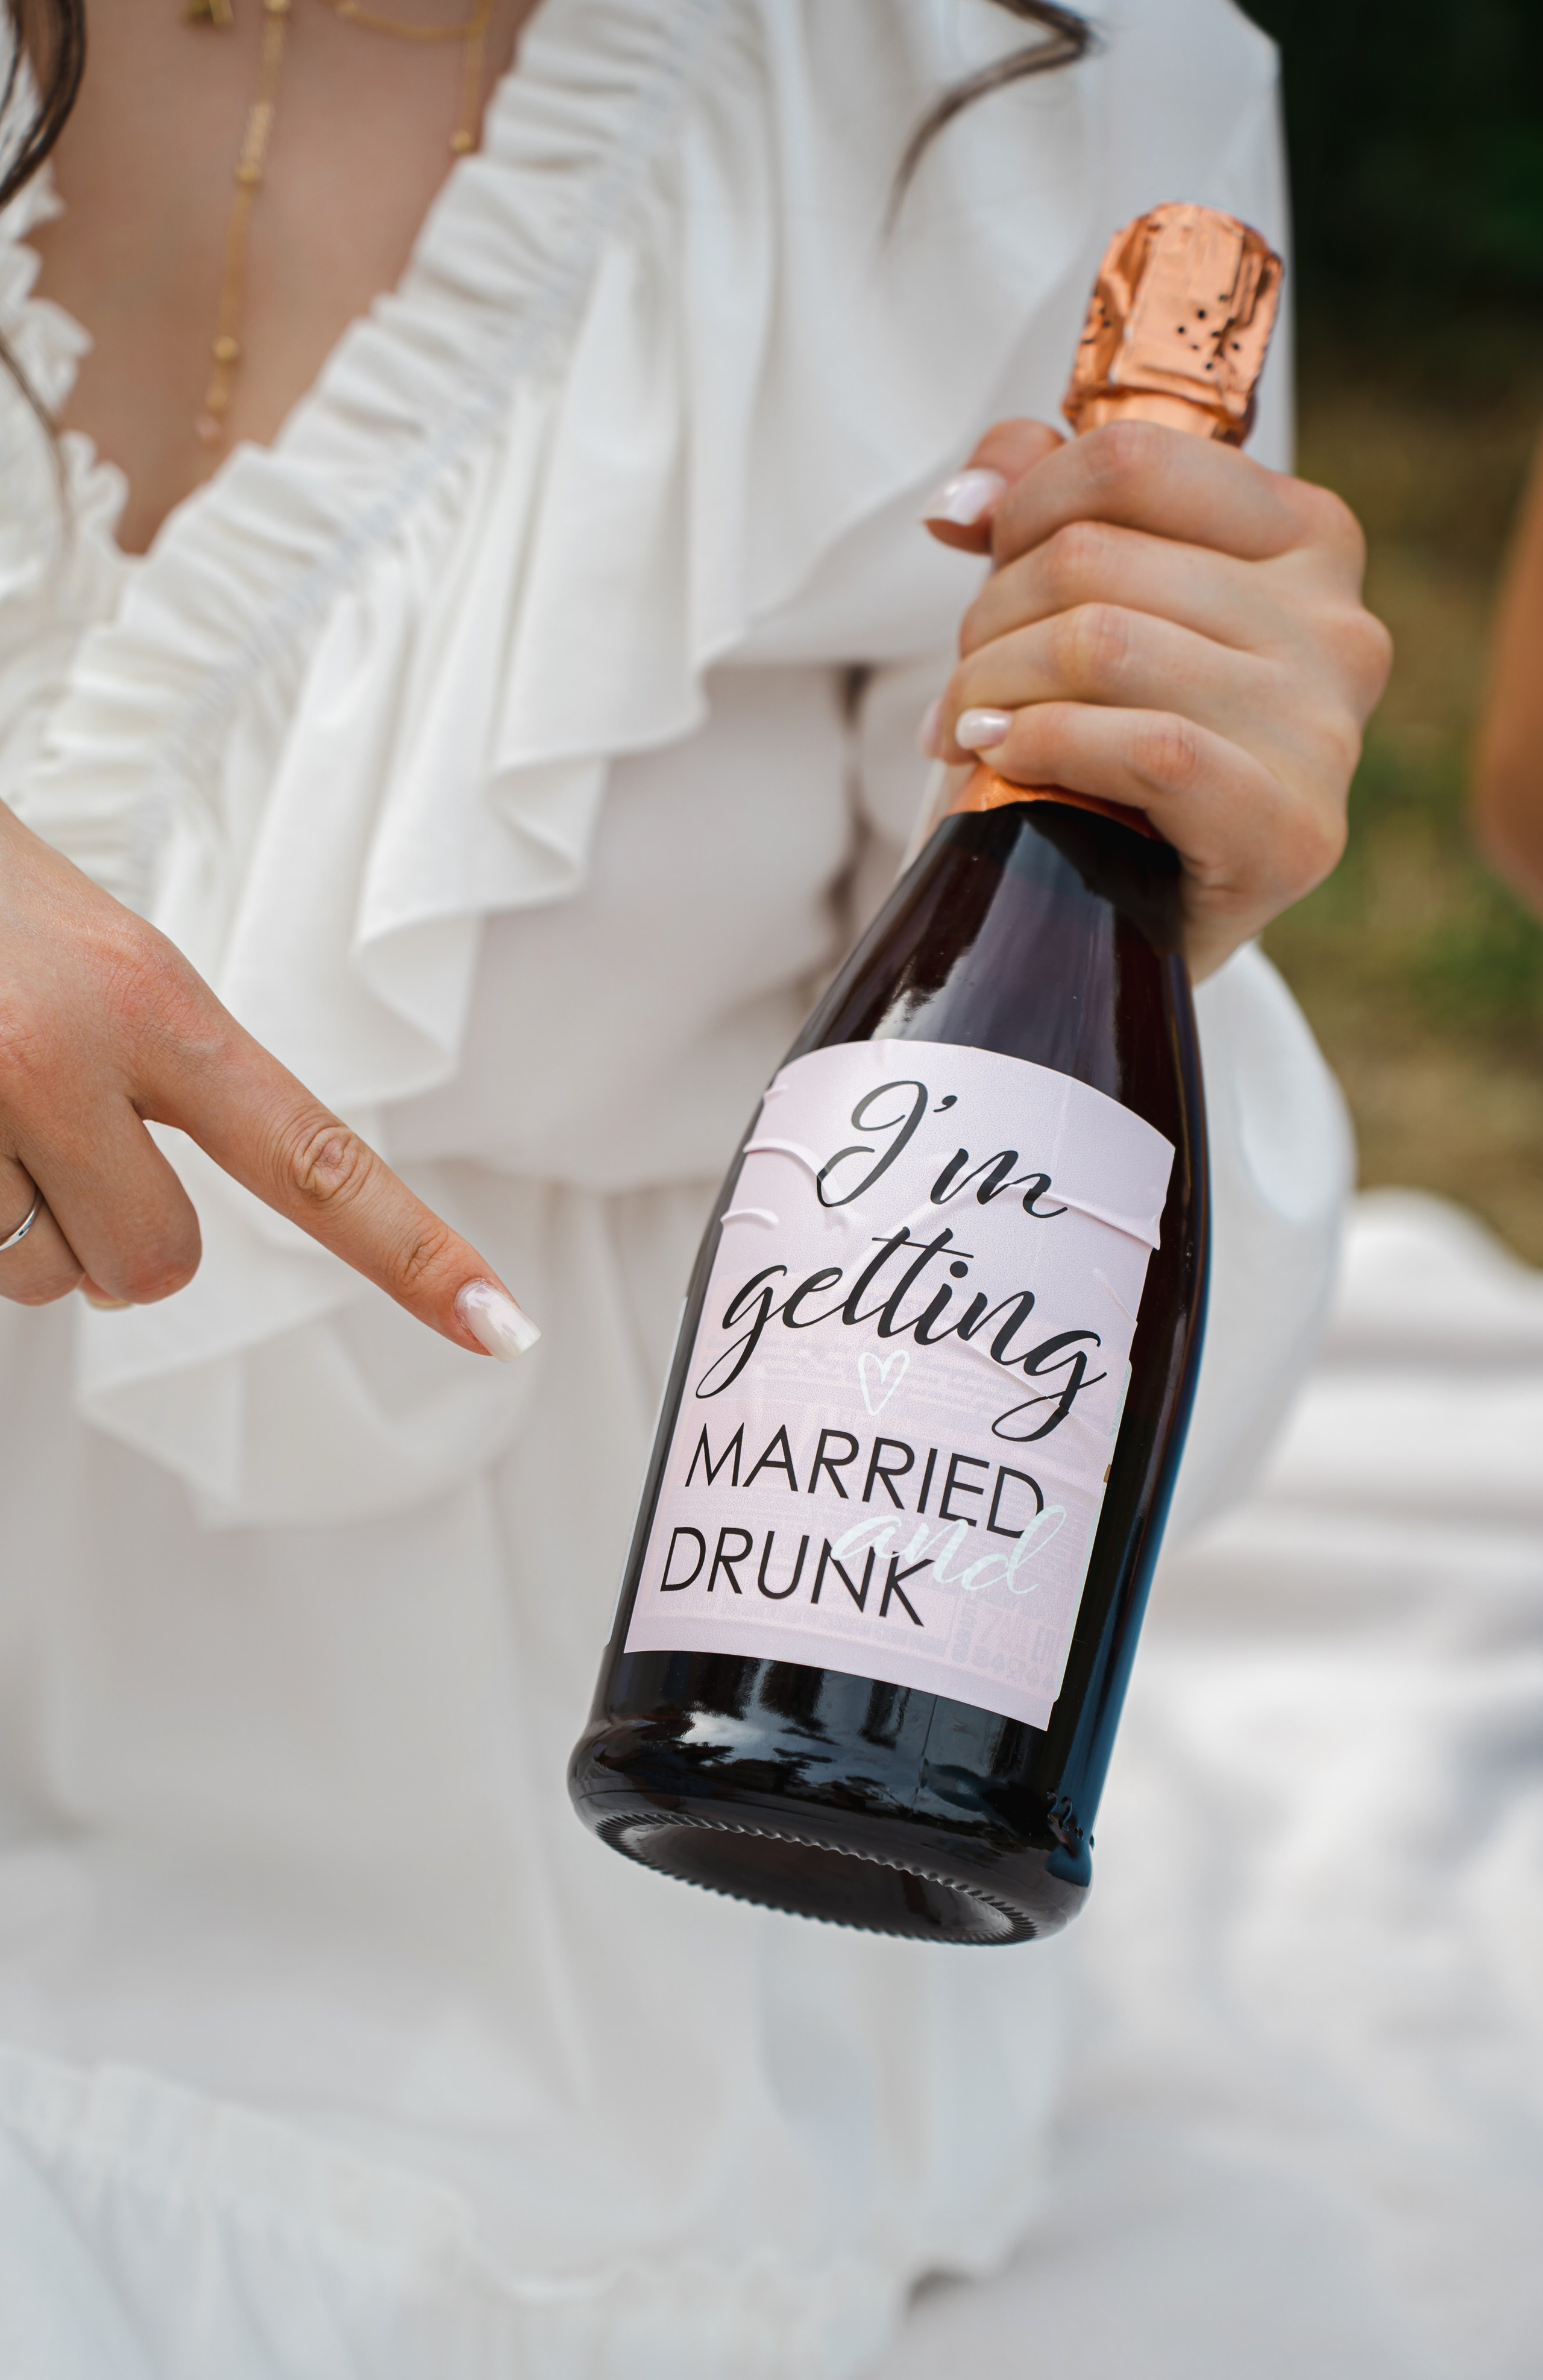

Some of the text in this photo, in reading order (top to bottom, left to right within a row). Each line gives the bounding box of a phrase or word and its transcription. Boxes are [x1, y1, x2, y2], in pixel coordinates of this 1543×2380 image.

[816, 1080, 1068, 1218] I'm
[696, 1226, 1108, 1443] getting
[685, 1421, 1045, 1539] MARRIED
[659, 1526, 937, 1627] DRUNK
[830, 1505, 1067, 1595] and
